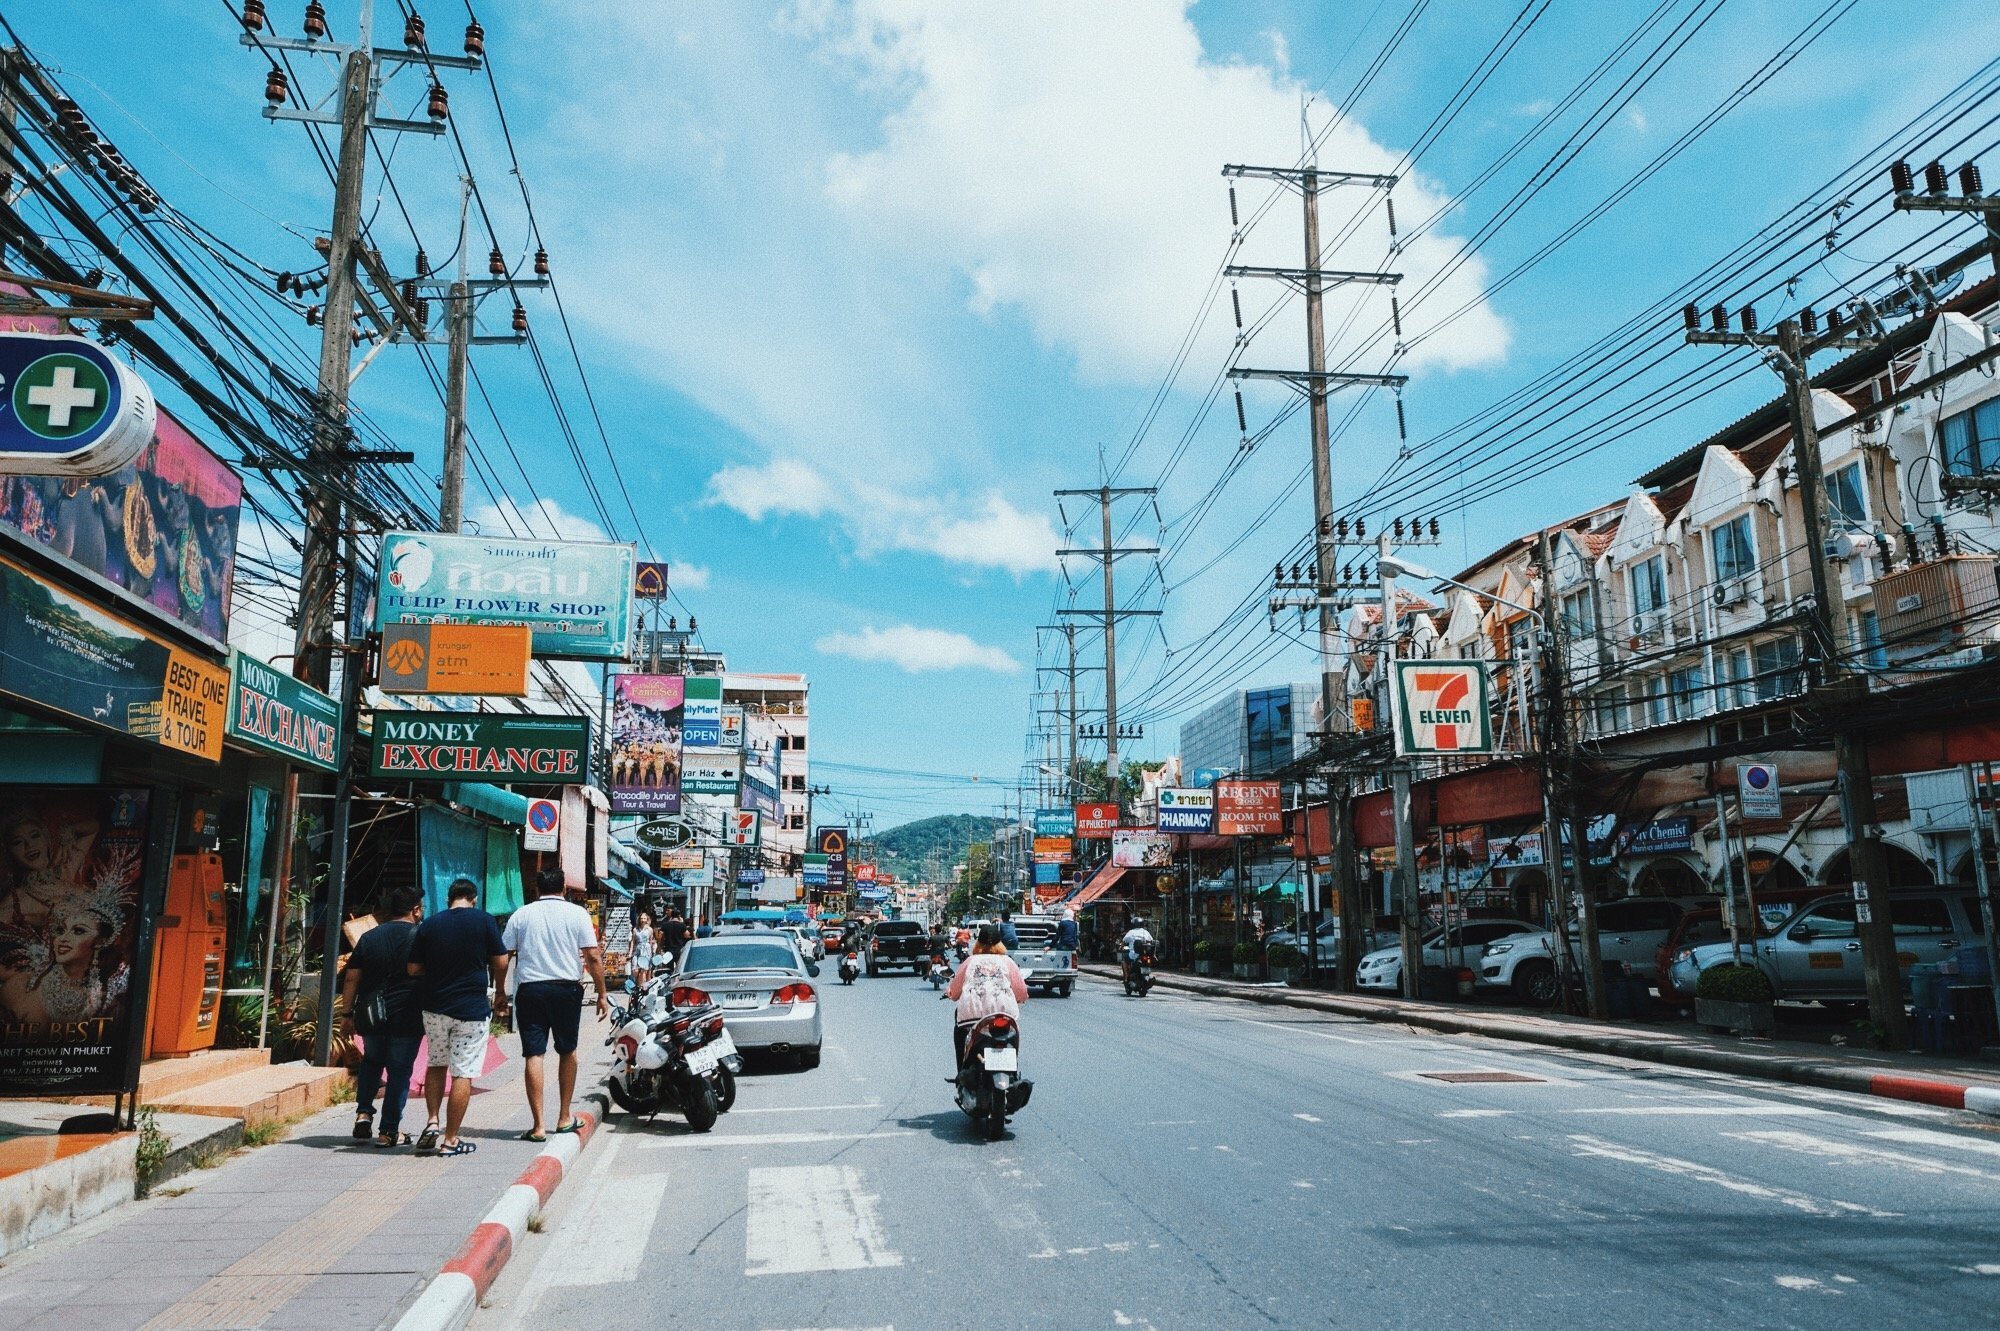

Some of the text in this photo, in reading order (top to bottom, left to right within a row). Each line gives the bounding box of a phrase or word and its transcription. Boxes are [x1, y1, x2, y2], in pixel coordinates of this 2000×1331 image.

[386, 595, 606, 616] TULIP FLOWER SHOP
[436, 654, 468, 667] atm
[169, 661, 225, 705] BEST ONE
[240, 659, 280, 698] MONEY
[631, 687, 678, 698] FantaSea
[167, 688, 208, 726] TRAVEL
[1415, 673, 1469, 749] 7
[238, 685, 336, 764] EXCHANGE
[383, 720, 480, 742] MONEY
[164, 717, 172, 741] &
[176, 722, 206, 752] TOUR
[684, 730, 718, 741] OPEN
[379, 743, 579, 775] EXCHANGE
[696, 781, 737, 790] Restaurant
[613, 790, 676, 801] Crocodile Junior
[1218, 786, 1279, 799] REGENT
[623, 801, 666, 809] Tour & Travel
[1177, 794, 1212, 805] ขายยา
[1160, 812, 1212, 828] PHARMACY
[1221, 812, 1280, 821] ROOM FOR
[1086, 819, 1107, 829] PHUKET
[1236, 824, 1266, 833] RENT
[1649, 823, 1687, 840] Chemist
[1516, 836, 1540, 850] aundry
[1654, 843, 1663, 851] and
[1664, 841, 1689, 850] Healthcare
[50, 1016, 114, 1044] BEST
[25, 1048, 58, 1057] SHOW
[60, 1047, 70, 1056] IN
[73, 1046, 112, 1056] PHUKET
